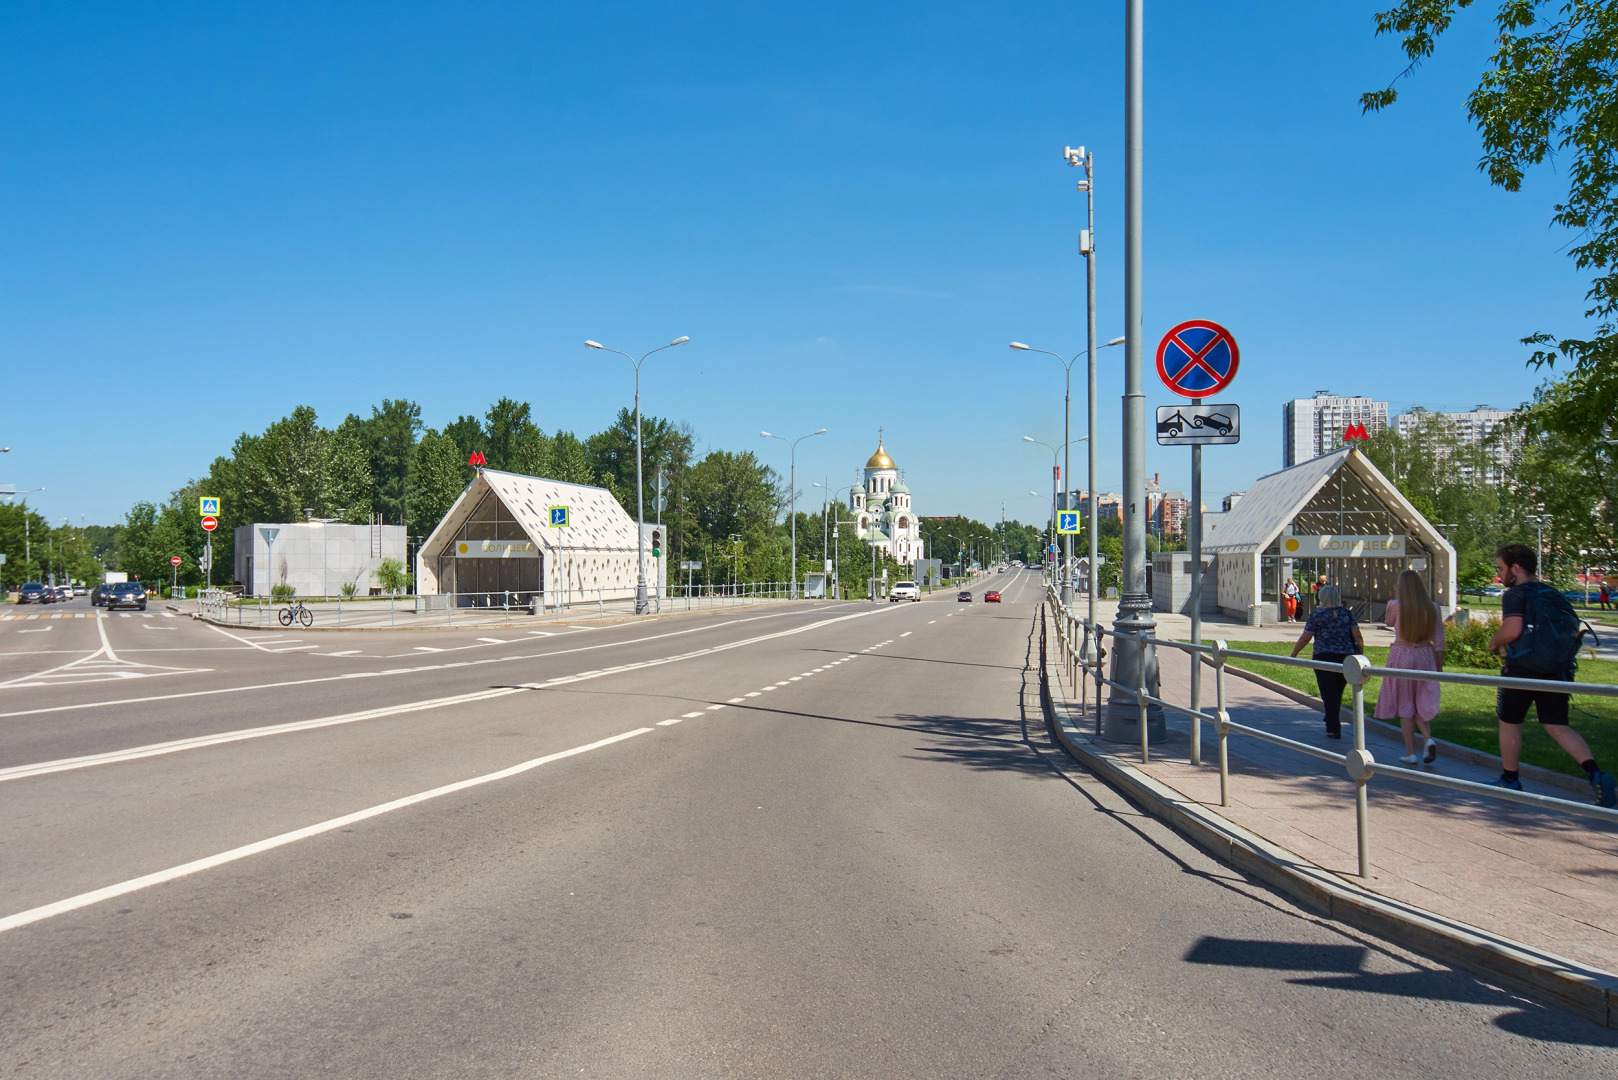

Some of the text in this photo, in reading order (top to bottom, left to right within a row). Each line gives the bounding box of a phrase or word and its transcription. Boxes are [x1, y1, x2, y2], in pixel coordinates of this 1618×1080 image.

[1342, 423, 1370, 440] М
[468, 451, 487, 466] М
[482, 544, 535, 553] СОЛНЦЕВО
[1321, 541, 1400, 552] СОЛНЦЕВО
